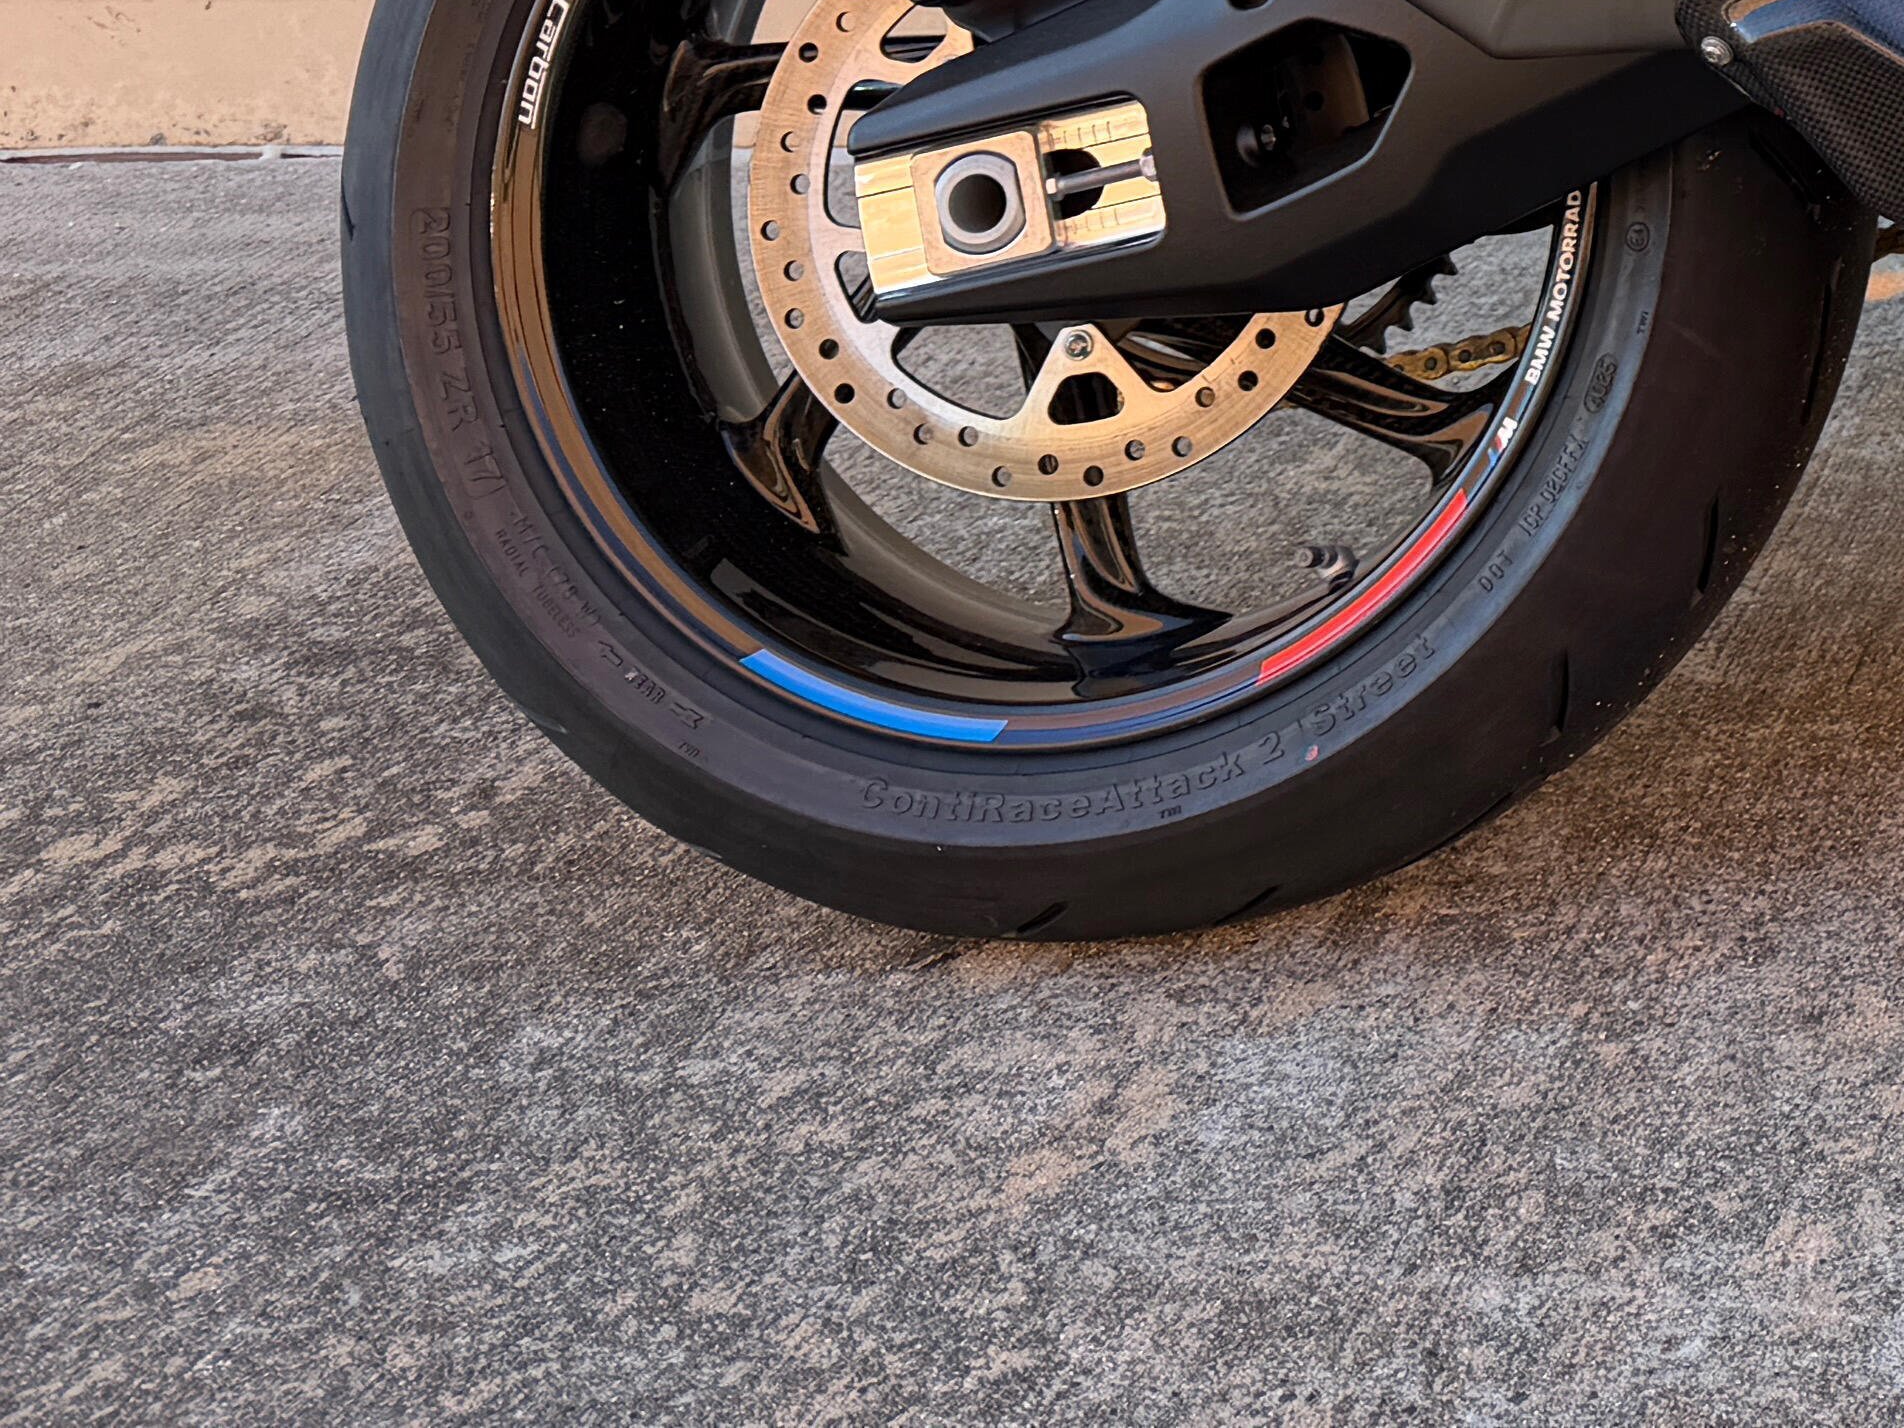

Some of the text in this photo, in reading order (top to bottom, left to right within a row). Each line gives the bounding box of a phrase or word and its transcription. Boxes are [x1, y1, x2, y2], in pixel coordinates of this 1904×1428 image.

[1523, 187, 1583, 388] BMW MOTORRAD
[1308, 635, 1438, 737] Street
